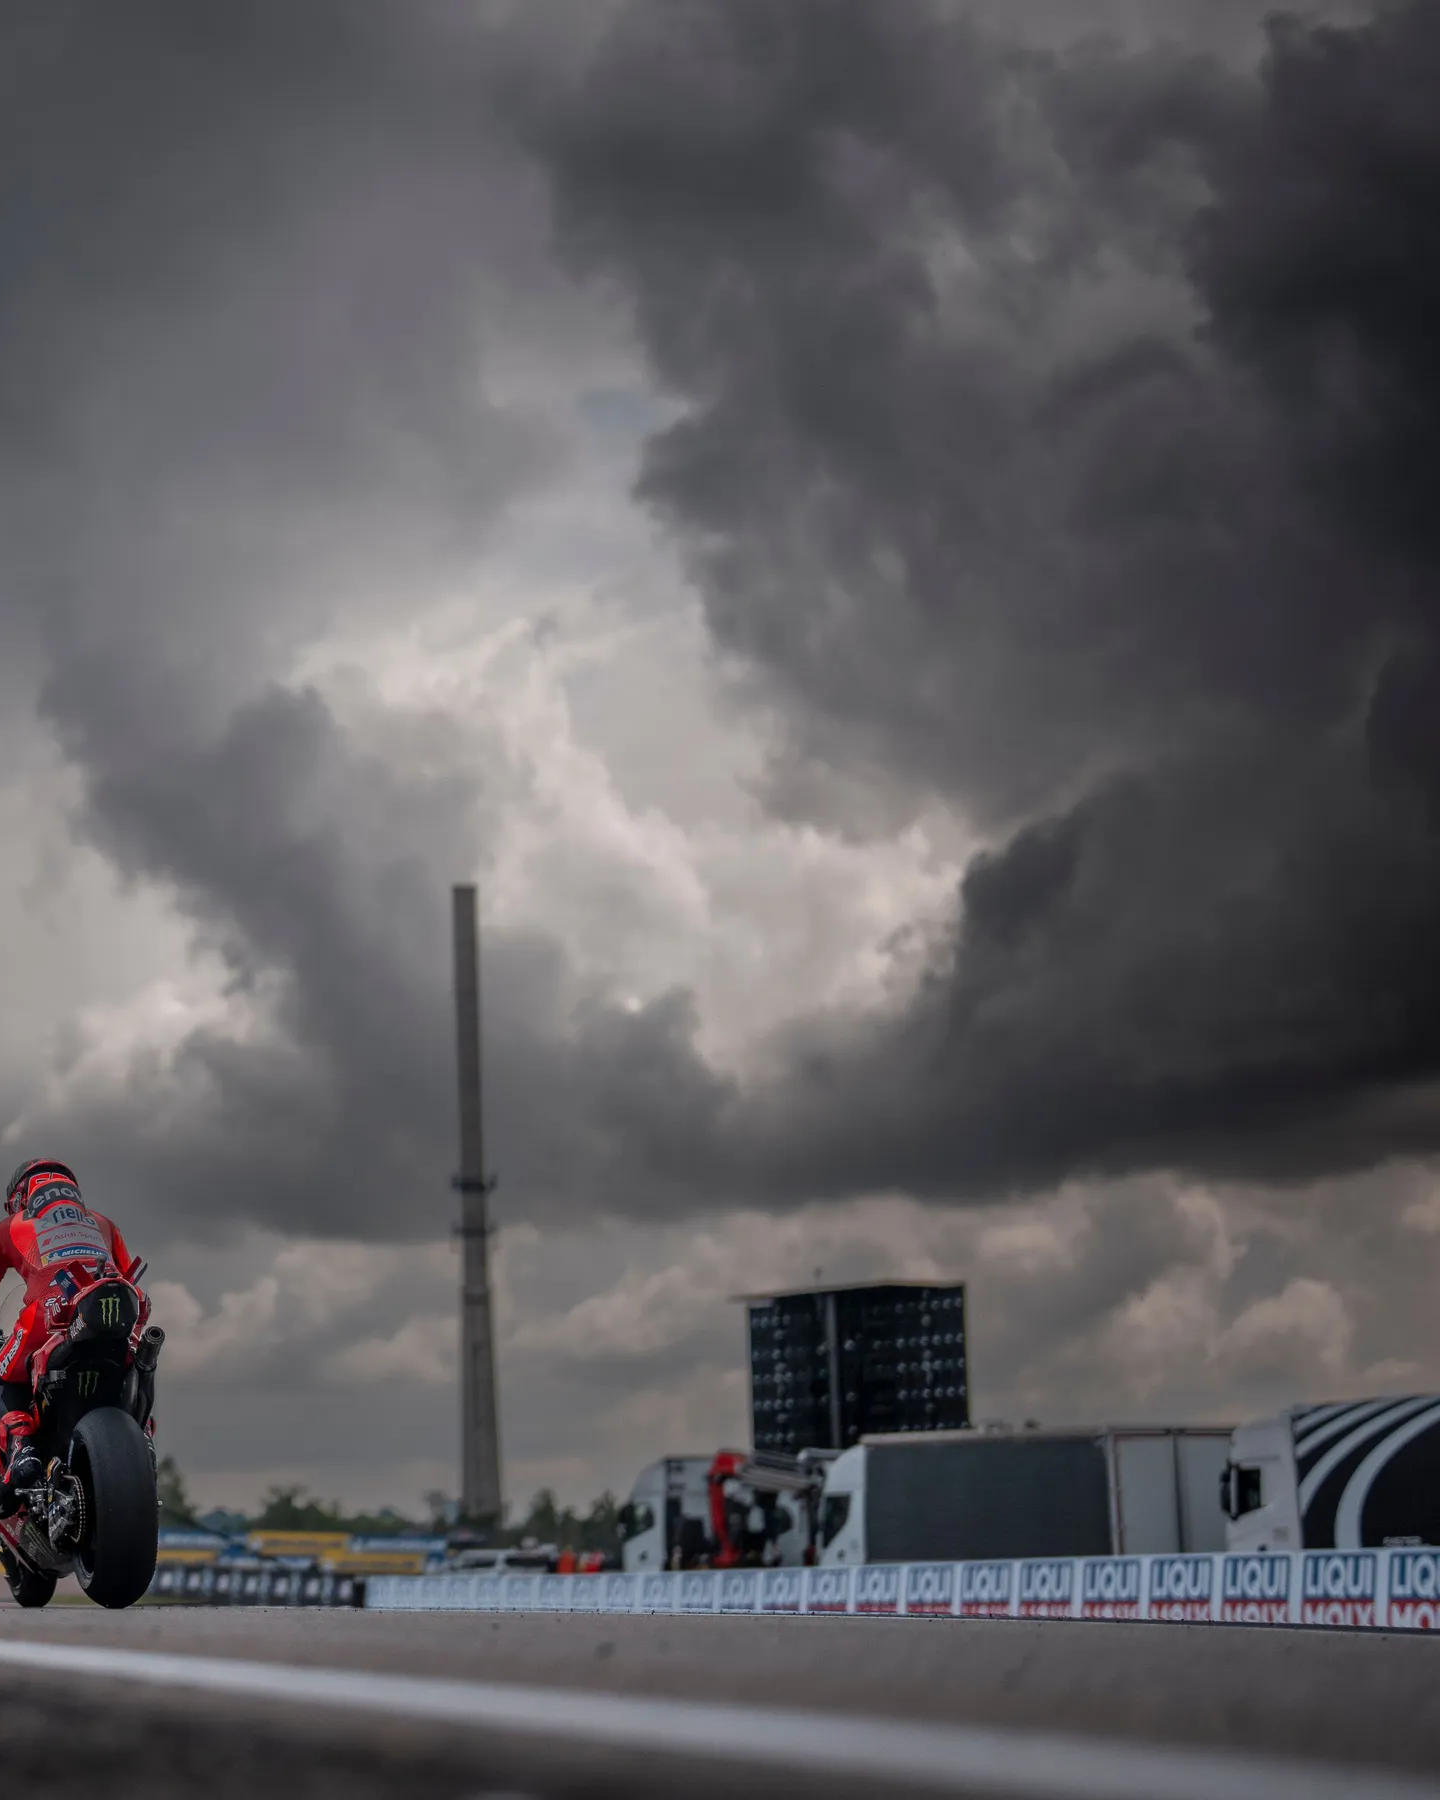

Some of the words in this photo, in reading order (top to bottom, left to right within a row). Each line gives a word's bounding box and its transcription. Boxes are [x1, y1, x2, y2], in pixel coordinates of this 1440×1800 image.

[962, 1567, 1009, 1600] LIQUI
[1022, 1563, 1071, 1599] LIQUI
[1086, 1562, 1138, 1598] LIQUI
[1152, 1561, 1210, 1598] LIQUI
[1226, 1557, 1288, 1597] LIQUI
[1306, 1556, 1373, 1598] LIQUI
